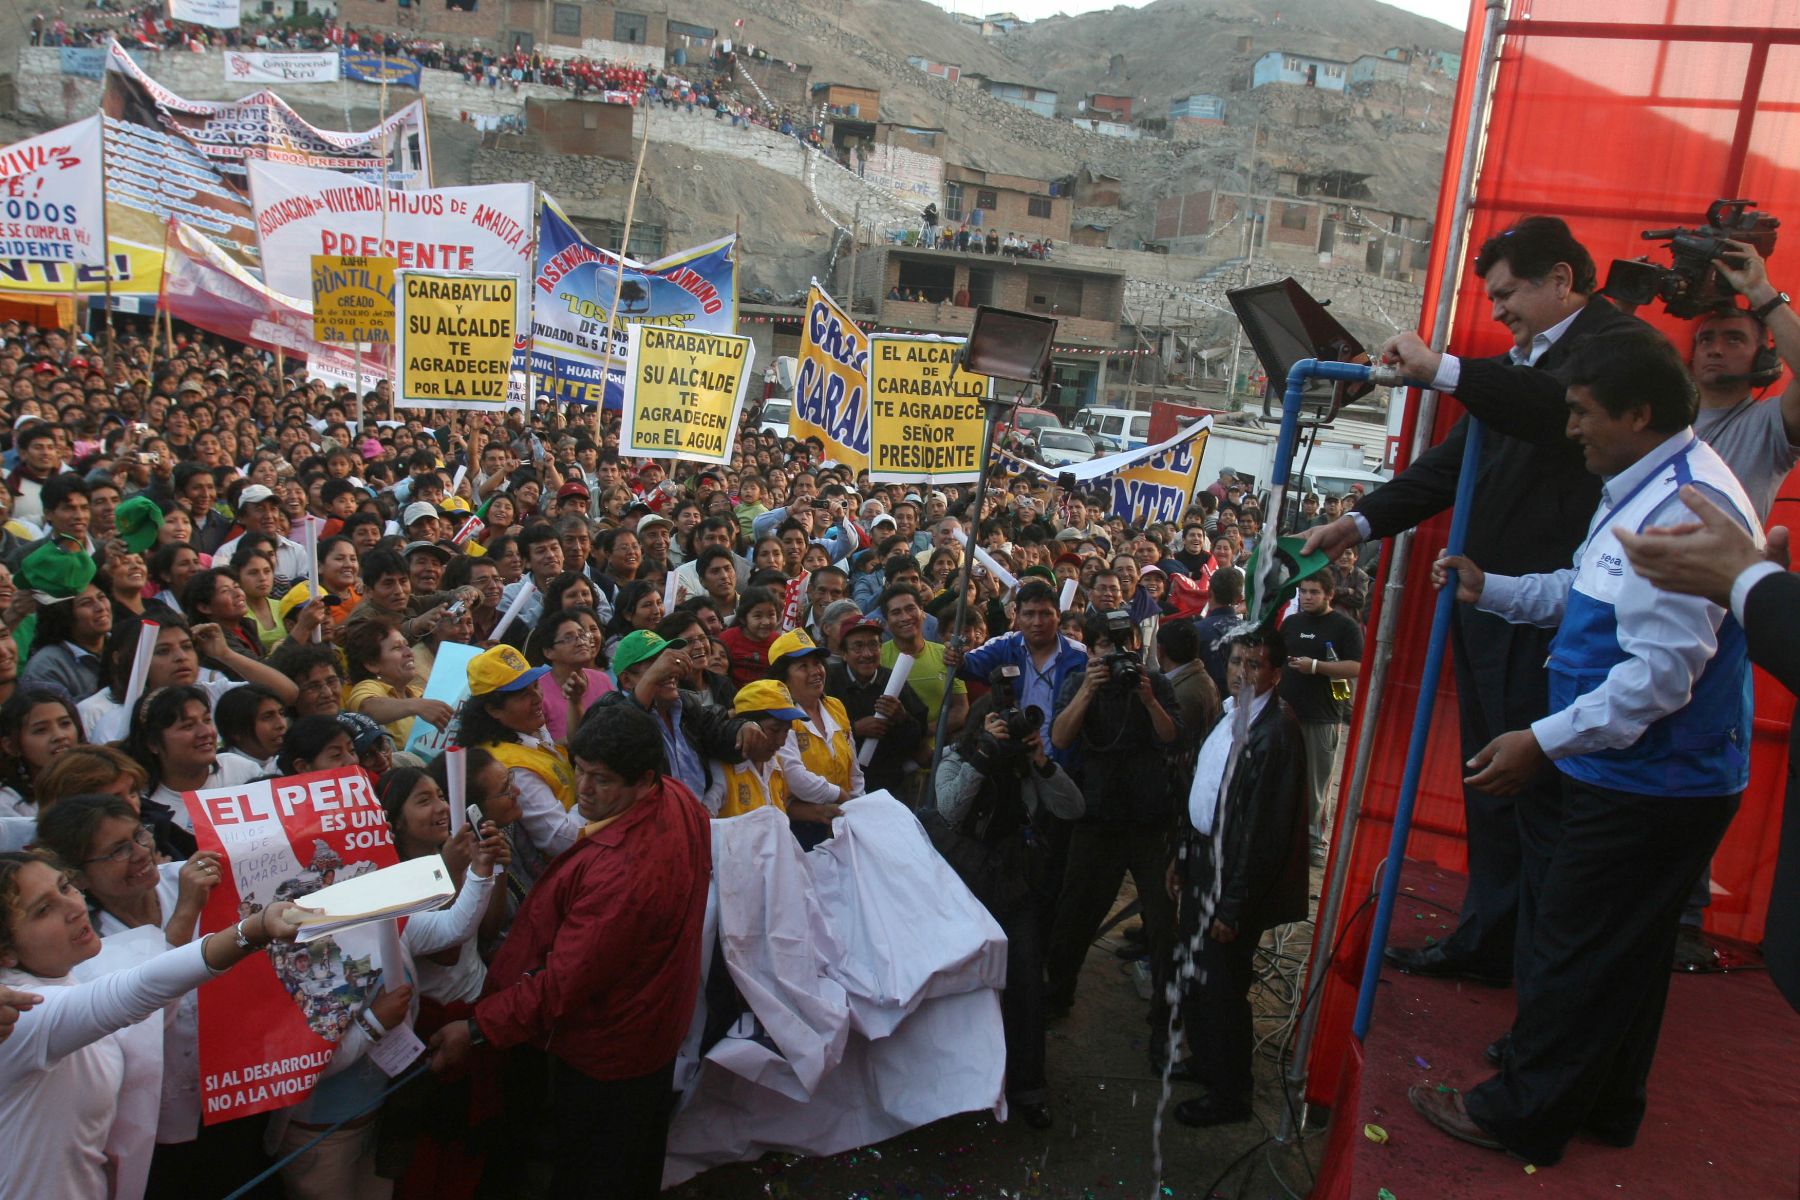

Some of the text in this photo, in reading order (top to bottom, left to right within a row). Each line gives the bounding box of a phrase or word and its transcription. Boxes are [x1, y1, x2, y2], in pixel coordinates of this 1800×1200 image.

[319, 186, 384, 214] VIVIENDA
[387, 190, 444, 217] HIJOS
[450, 198, 468, 216] DE
[407, 280, 512, 303] CARABAYLLO
[456, 304, 463, 315] Y
[409, 315, 511, 338] SU ALCALDE
[448, 341, 471, 357] TE
[591, 338, 599, 351] 5
[645, 330, 744, 360] CARABAYLLO
[882, 345, 902, 361] EL
[409, 357, 509, 375] AGRADECEN
[689, 355, 697, 366] Y
[643, 364, 736, 394] SU ALCALDE
[922, 366, 939, 377] DE
[414, 382, 440, 395] POR
[444, 378, 466, 396] LA
[471, 380, 503, 397] LUZ
[877, 377, 983, 397] CARABAYLLO
[679, 391, 700, 408] TE
[640, 406, 728, 430] AGRADECEN
[874, 401, 985, 420] TE AGRADECE
[635, 428, 723, 453] POR EL AGUA
[902, 424, 955, 443] SEÑOR
[879, 444, 976, 469] PRESIDENTE
[205, 793, 269, 826] EL
[320, 812, 347, 832] ES
[233, 850, 287, 876] TUPAC
[240, 862, 290, 891] AMARU
[205, 1049, 334, 1092] SI AL DESARROLLO
[207, 1094, 232, 1113] NO
[234, 1090, 247, 1107] A
[248, 1085, 269, 1104] LA
